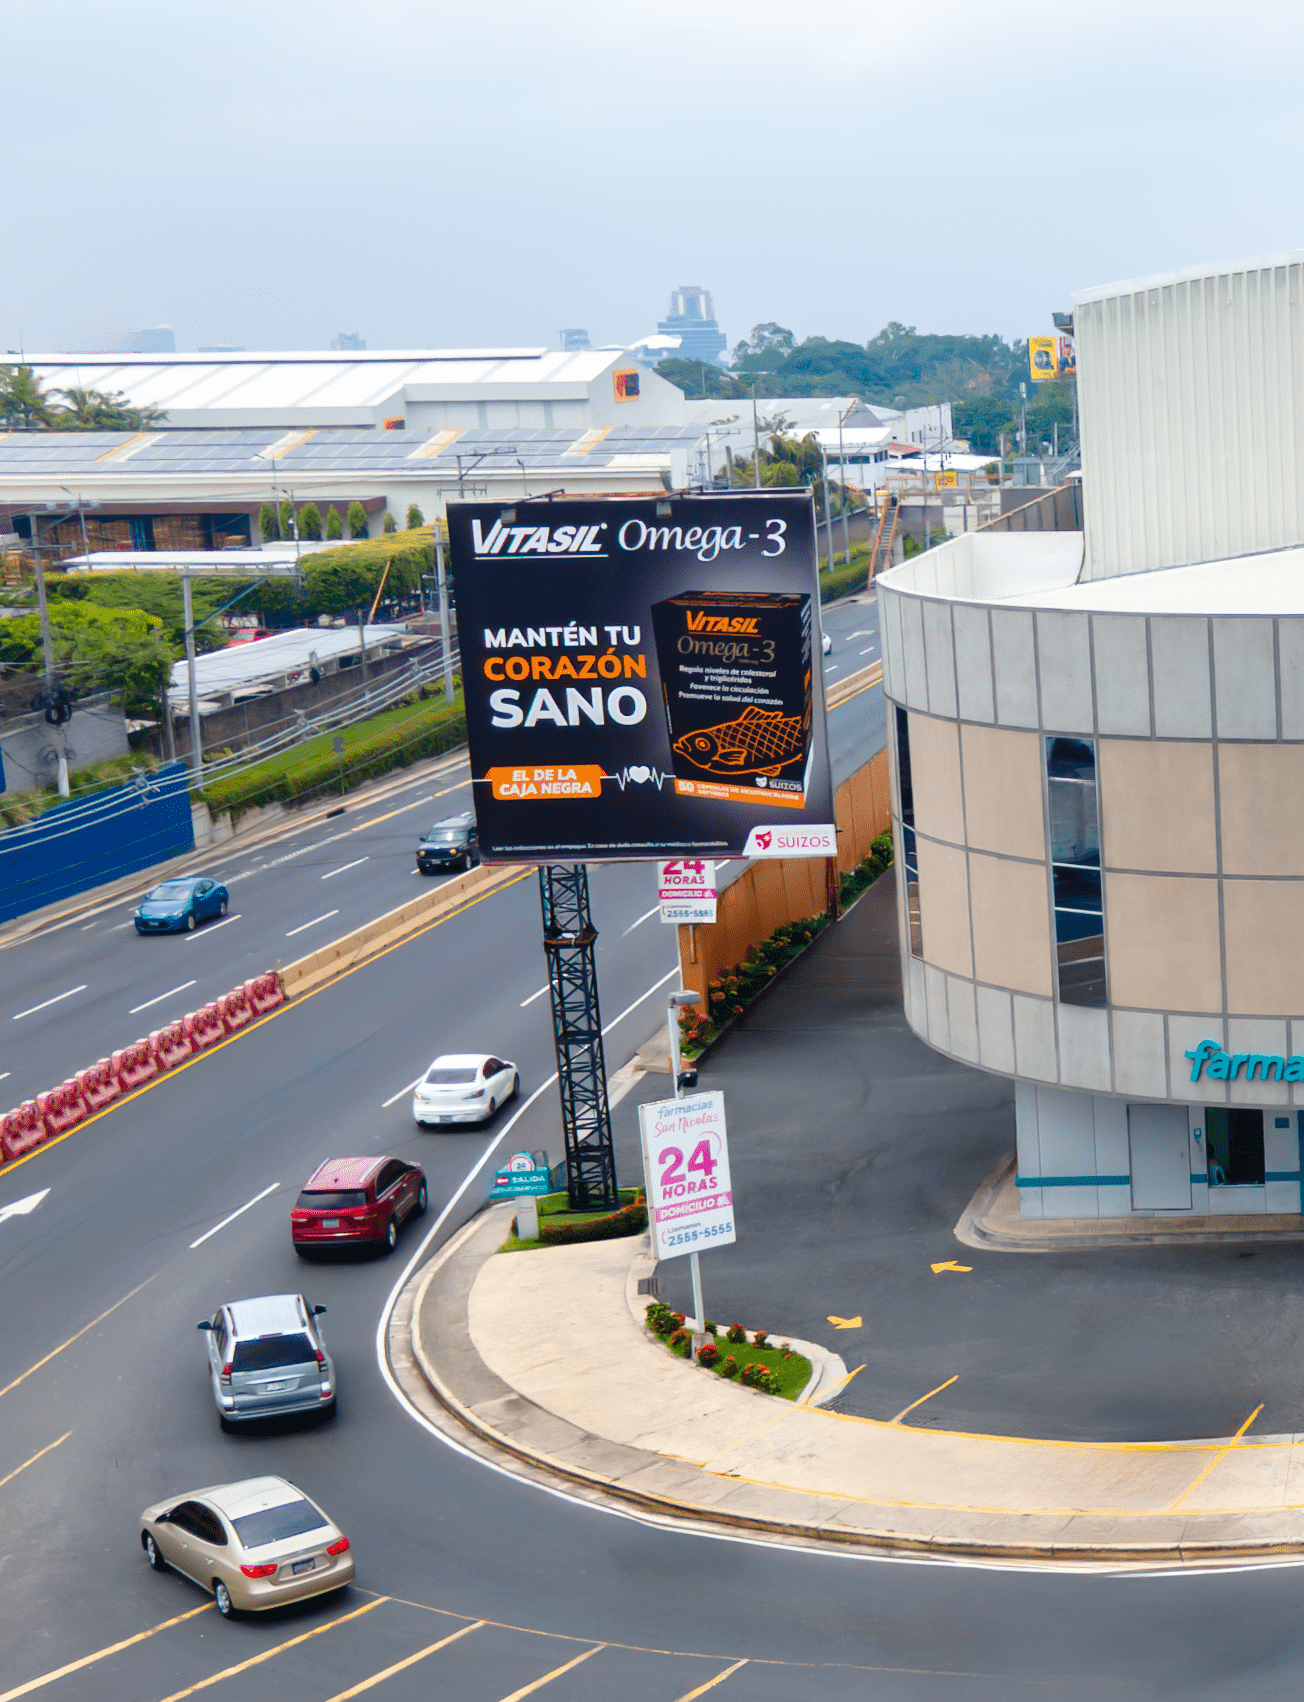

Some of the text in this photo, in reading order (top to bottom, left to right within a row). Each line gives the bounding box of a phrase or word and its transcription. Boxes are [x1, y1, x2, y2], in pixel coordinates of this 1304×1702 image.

[472, 518, 788, 562] VITASIL Omega-3
[686, 610, 759, 633] VITASIL
[483, 620, 641, 648] MANTÉN TU
[677, 635, 776, 664] Omega-3
[483, 647, 647, 681] CORAZÓN
[721, 694, 741, 702] salud
[730, 685, 769, 695] circulación
[489, 685, 648, 729] SANO
[512, 768, 577, 781] EL DE LA
[499, 781, 593, 797] CAJA NEGRA
[769, 781, 802, 791] SUIZOS
[777, 836, 830, 848] SUIZOS
[662, 859, 706, 875] 24
[663, 876, 705, 885] HORAS
[653, 1121, 676, 1138] San
[657, 1139, 718, 1187] 24
[512, 1175, 546, 1183] SALIDA
[662, 1176, 718, 1200] HORAS
[660, 1198, 715, 1218] DOMICILIO
[668, 1222, 733, 1247] 2555-5555
